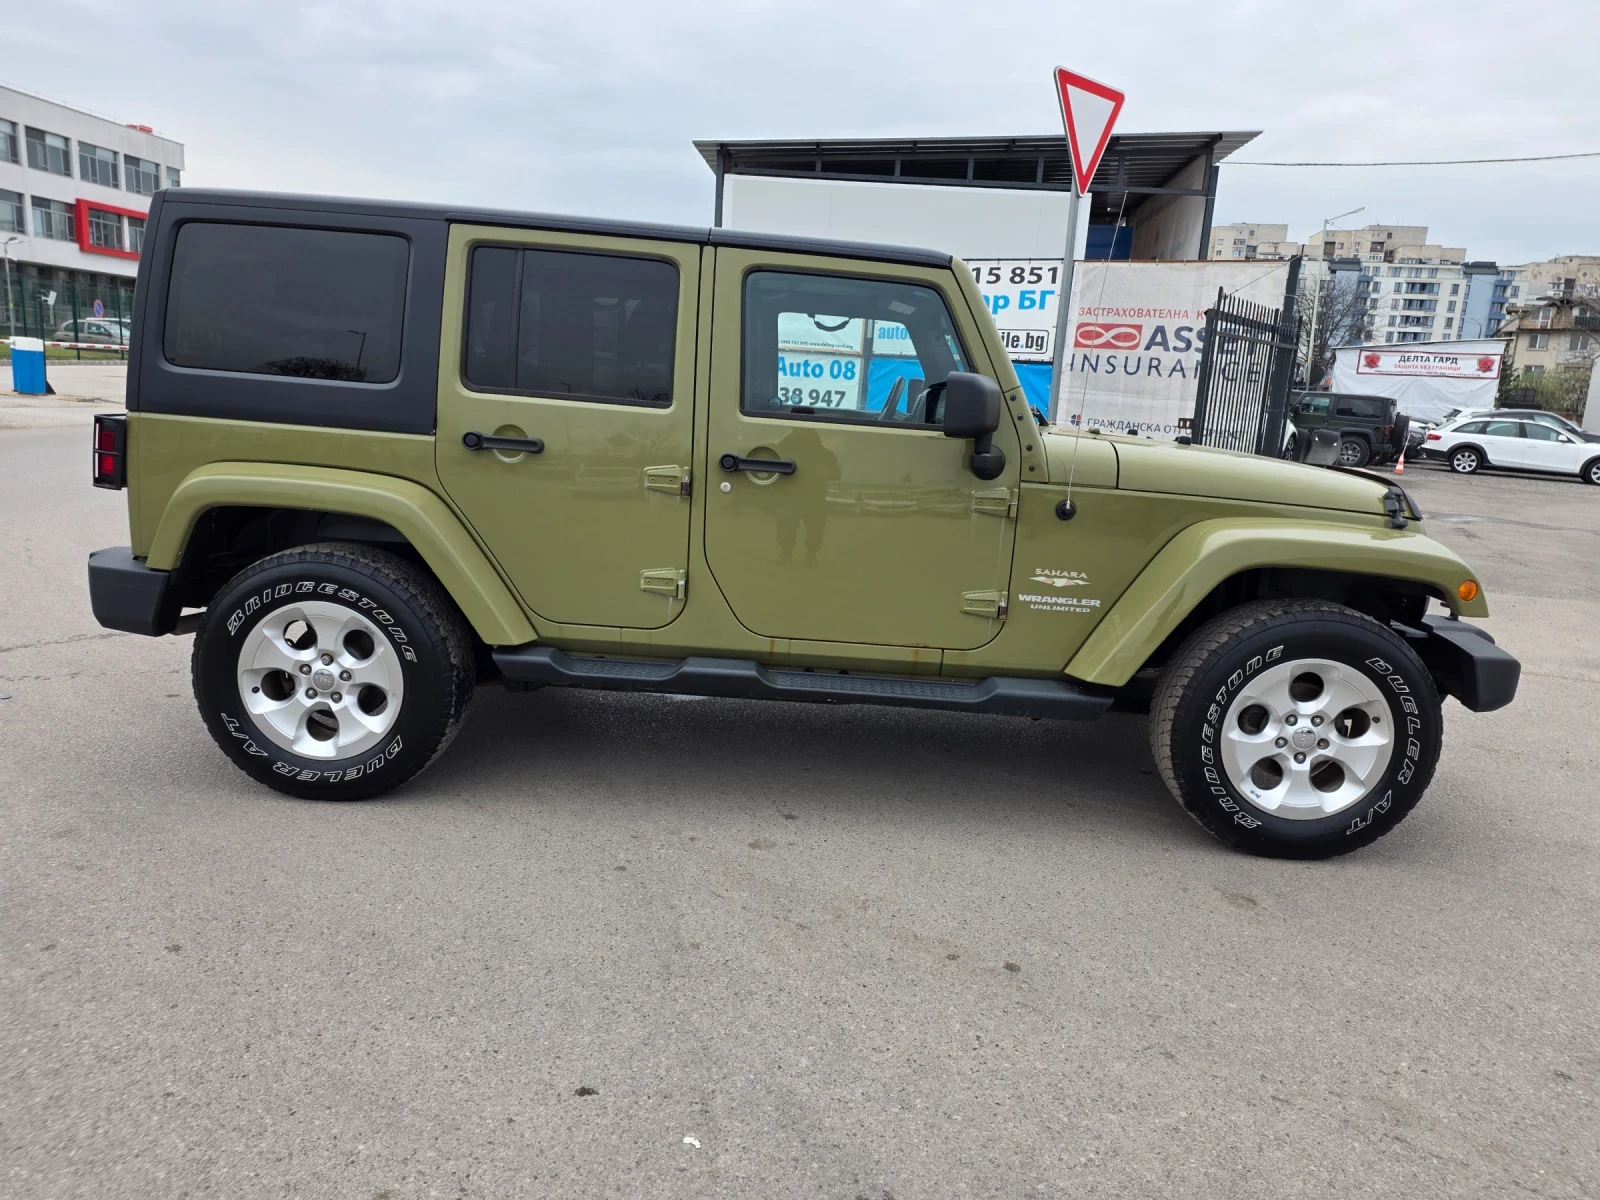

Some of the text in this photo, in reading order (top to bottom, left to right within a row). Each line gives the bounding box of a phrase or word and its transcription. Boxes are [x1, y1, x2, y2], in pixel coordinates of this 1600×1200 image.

[1009, 266, 1058, 285] 851
[1018, 290, 1056, 310] БГ
[1078, 307, 1189, 320] ЗАСТРАХОВАТЕЛНА
[778, 356, 856, 381] Auto 08
[1398, 355, 1458, 365] ДЕЛТА ГАРД
[779, 387, 846, 408] 38 947
[1087, 418, 1161, 434] ГРАЖДАНСКА
[1035, 568, 1088, 579] SAHARA
[1018, 594, 1101, 608] WRANGLER
[1030, 604, 1091, 613] UNLIMITED
[227, 581, 418, 663] BRIDGESTONE
[1201, 645, 1285, 829] BRIDGESTONE
[1346, 657, 1422, 835] DUELER A/T
[220, 712, 403, 783] DUELER A/T
